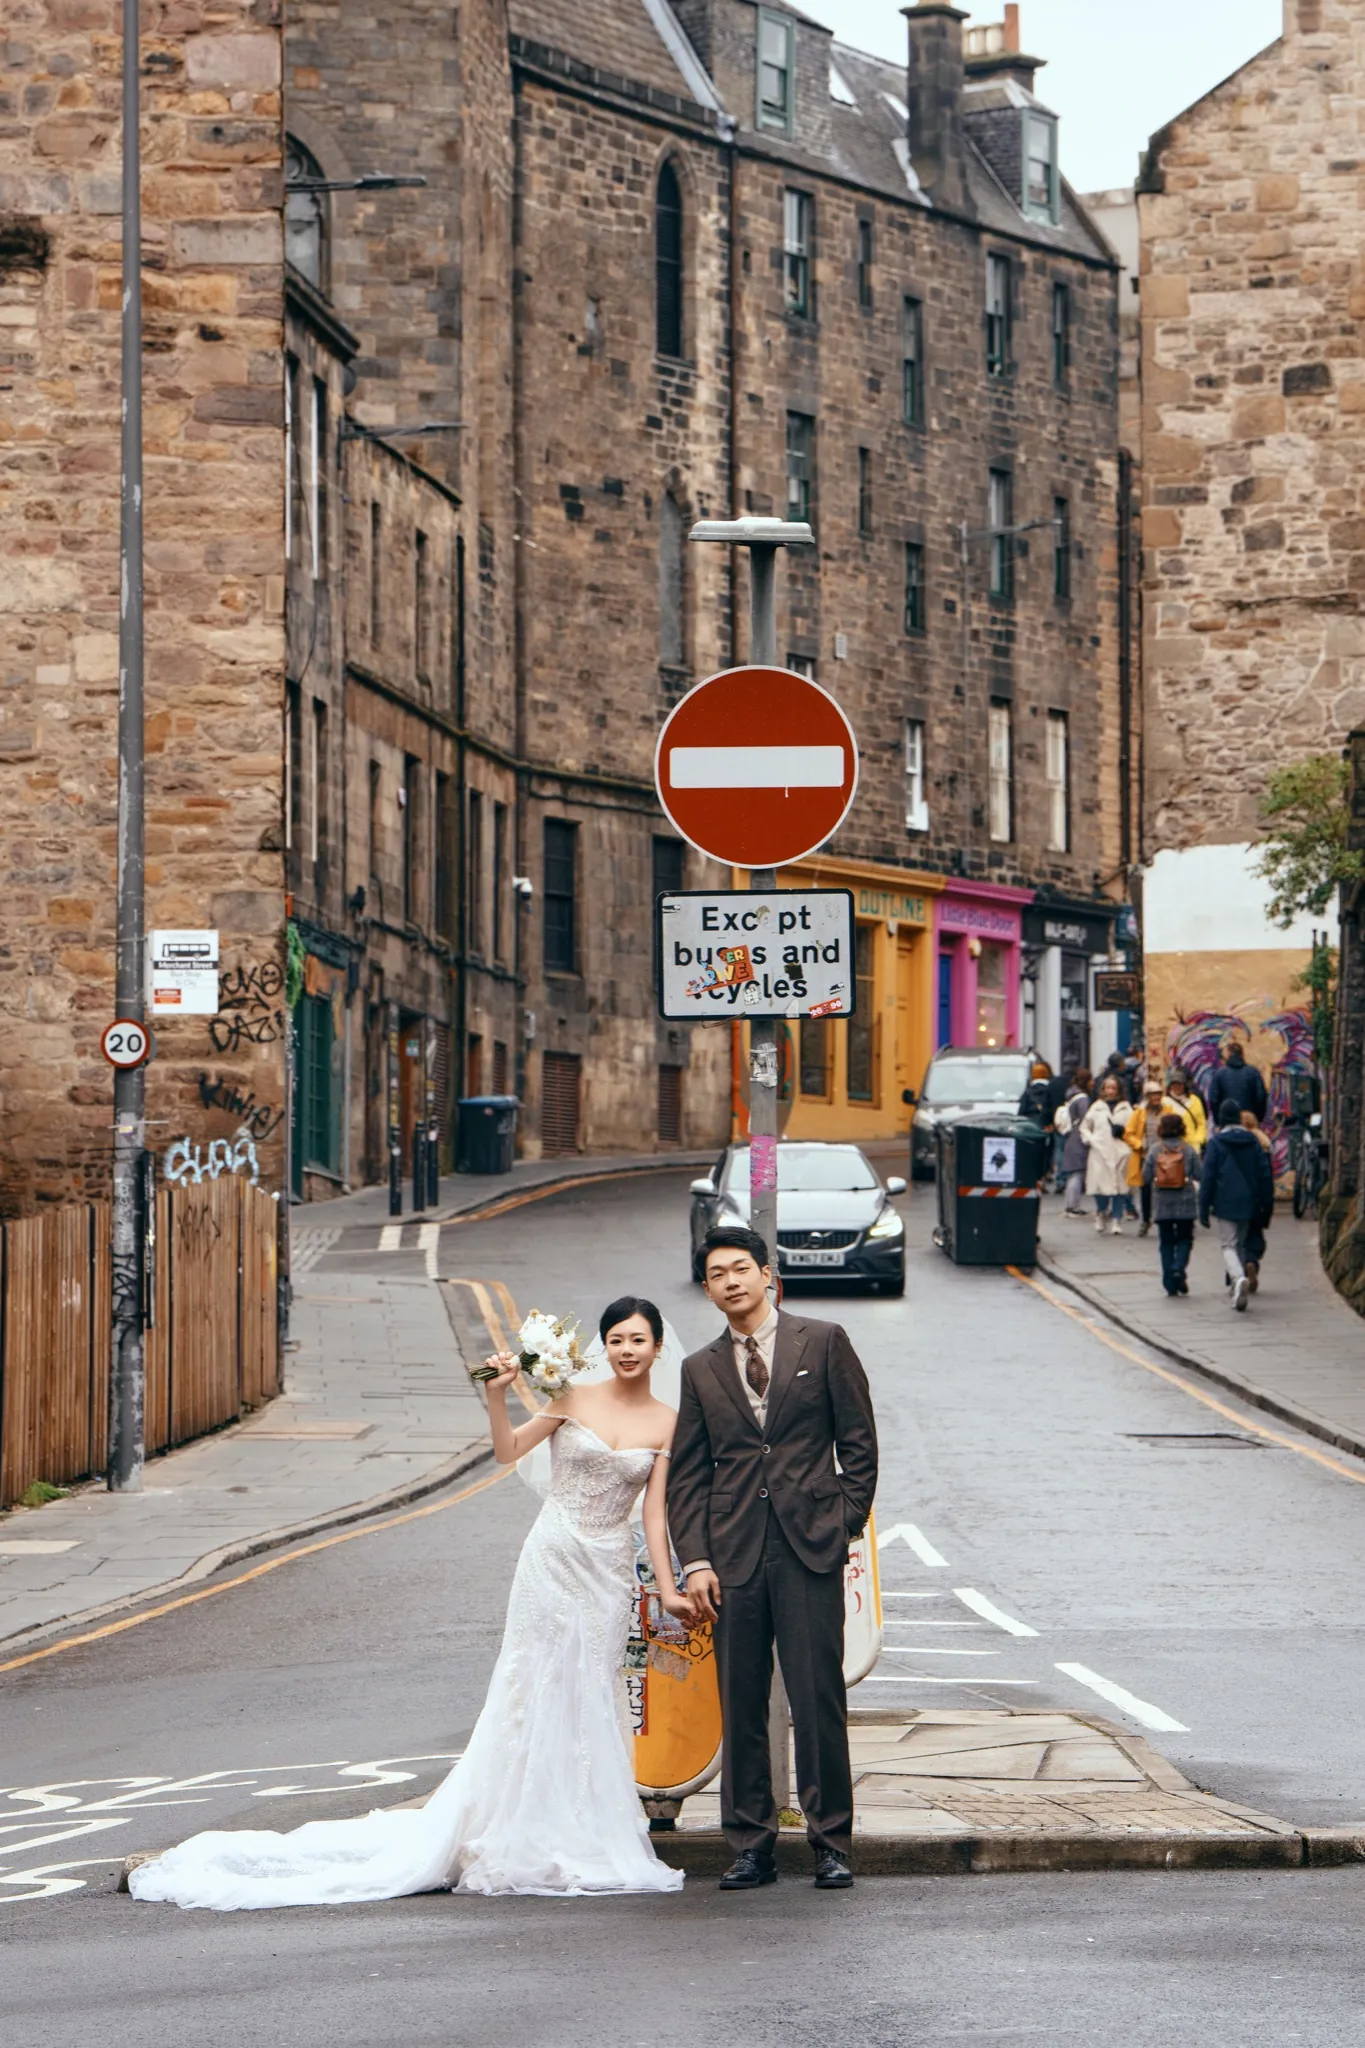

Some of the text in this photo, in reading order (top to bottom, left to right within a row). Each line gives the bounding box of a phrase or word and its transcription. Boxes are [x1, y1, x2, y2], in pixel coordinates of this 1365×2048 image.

[702, 905, 811, 935] Excpt
[674, 938, 840, 966] bus and
[109, 1033, 142, 1053] 20
